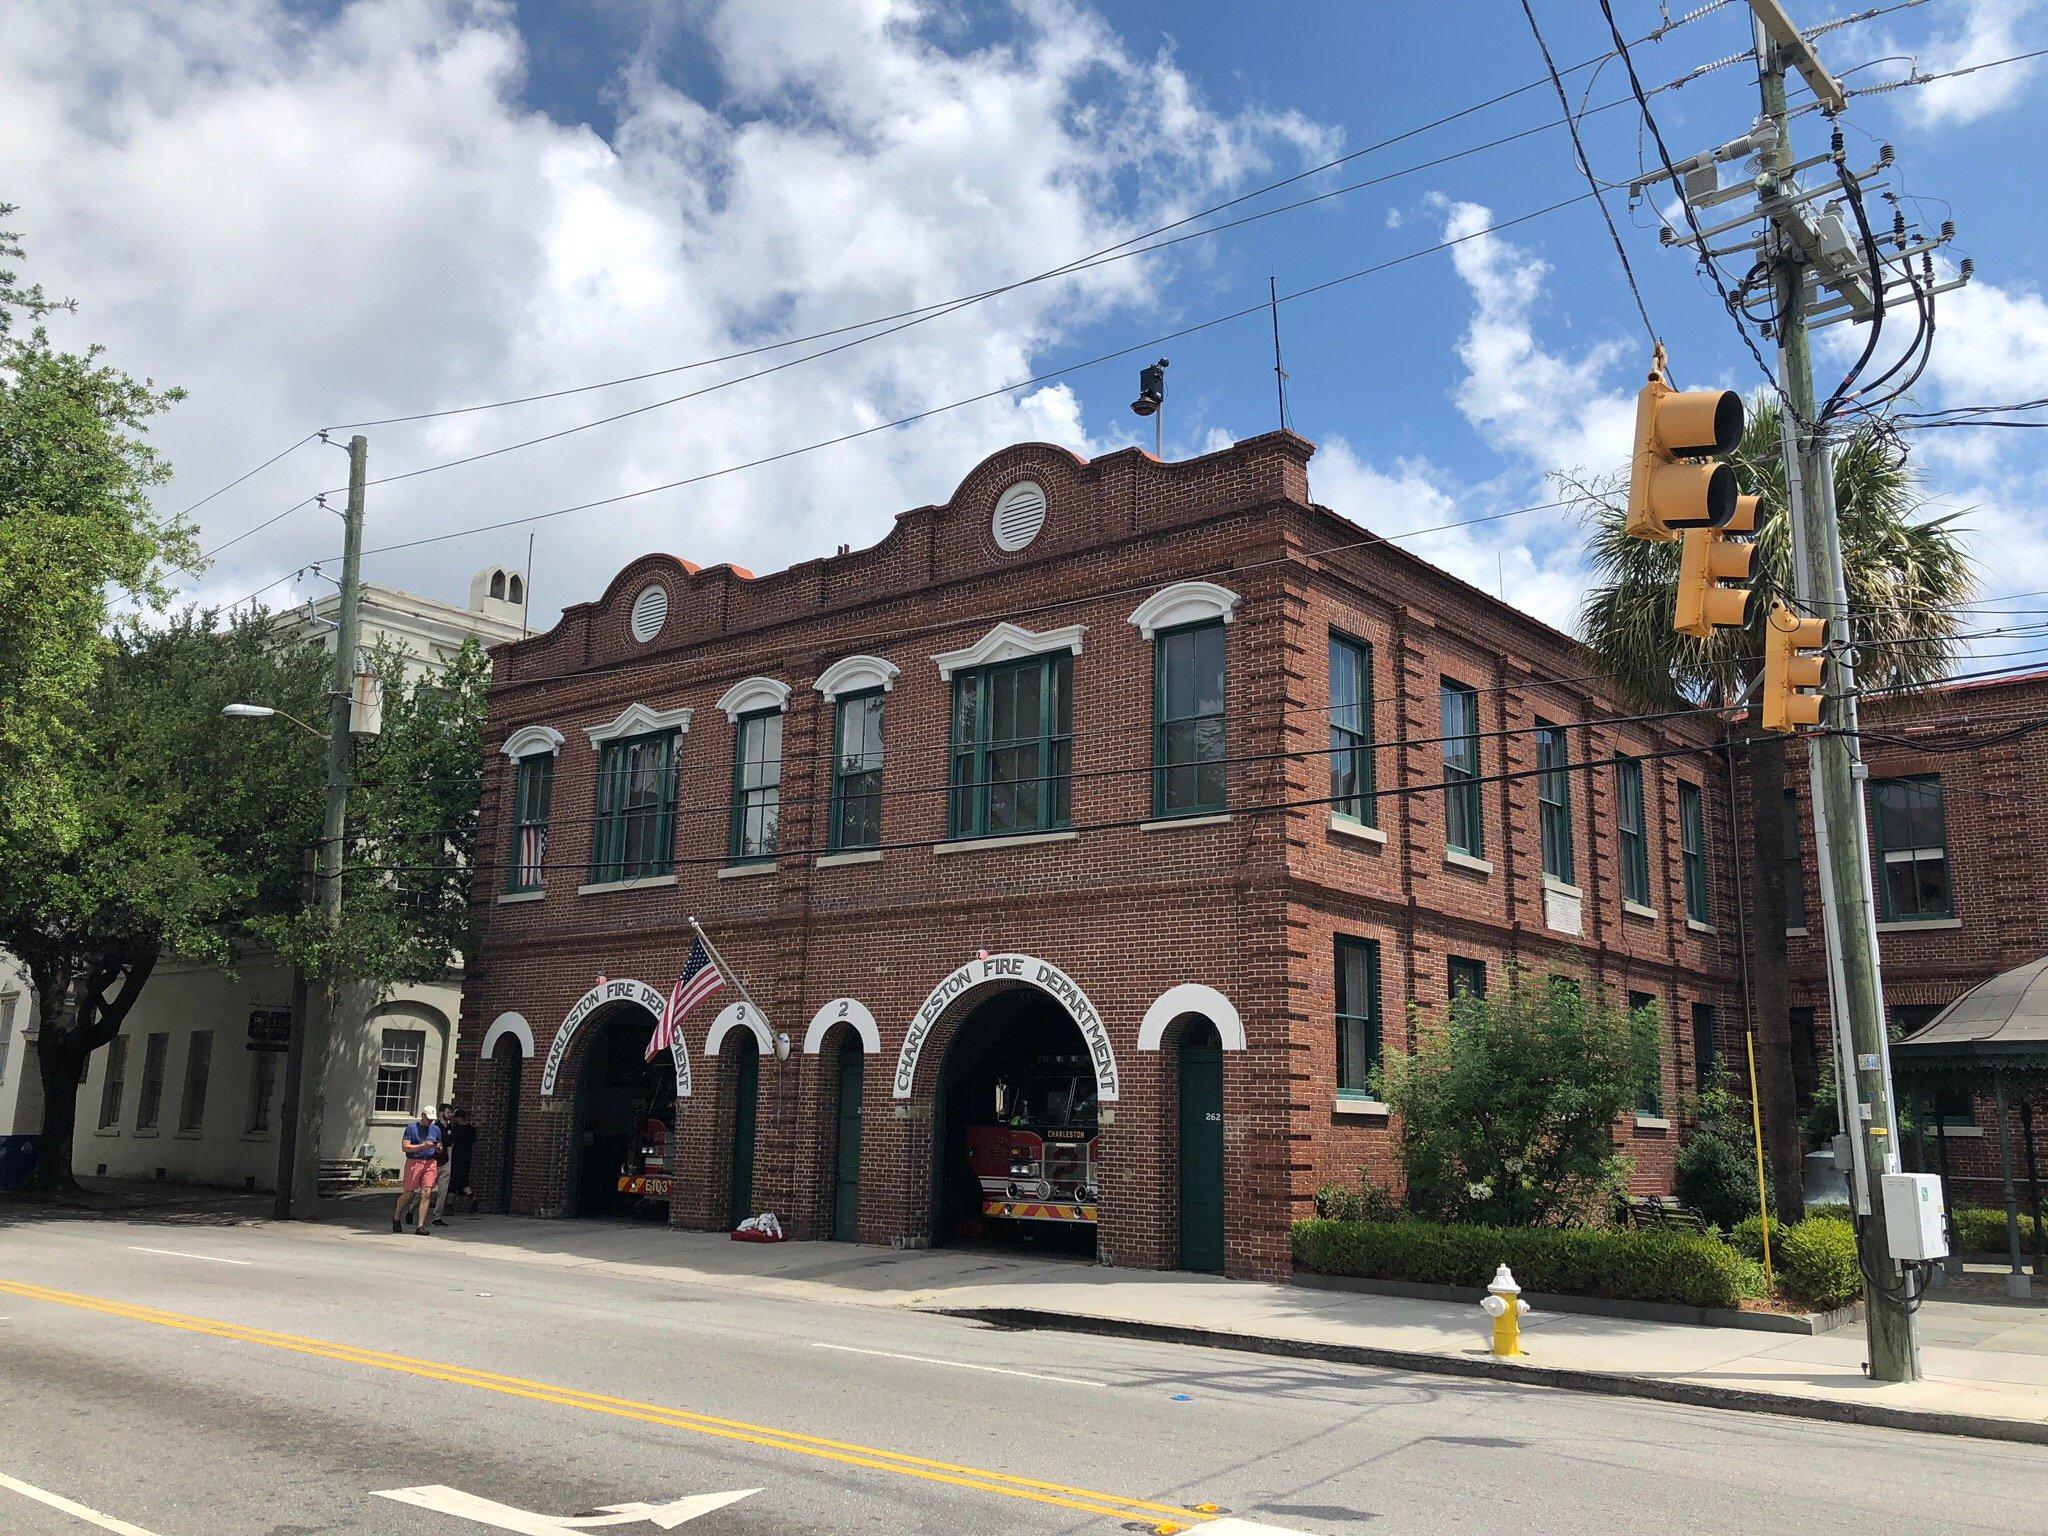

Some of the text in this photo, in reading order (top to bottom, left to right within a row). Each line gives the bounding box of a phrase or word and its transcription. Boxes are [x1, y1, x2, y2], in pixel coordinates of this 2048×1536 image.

[736, 1005, 746, 1020] 3
[838, 1001, 849, 1017] 2
[898, 958, 1115, 1093] CHARLESTON FIRE DEPARTMENT
[544, 983, 689, 1090] CHARLESTON FIRE DEPMENT
[1205, 1112, 1221, 1121] 262
[1047, 1130, 1085, 1139] CHARLESTON
